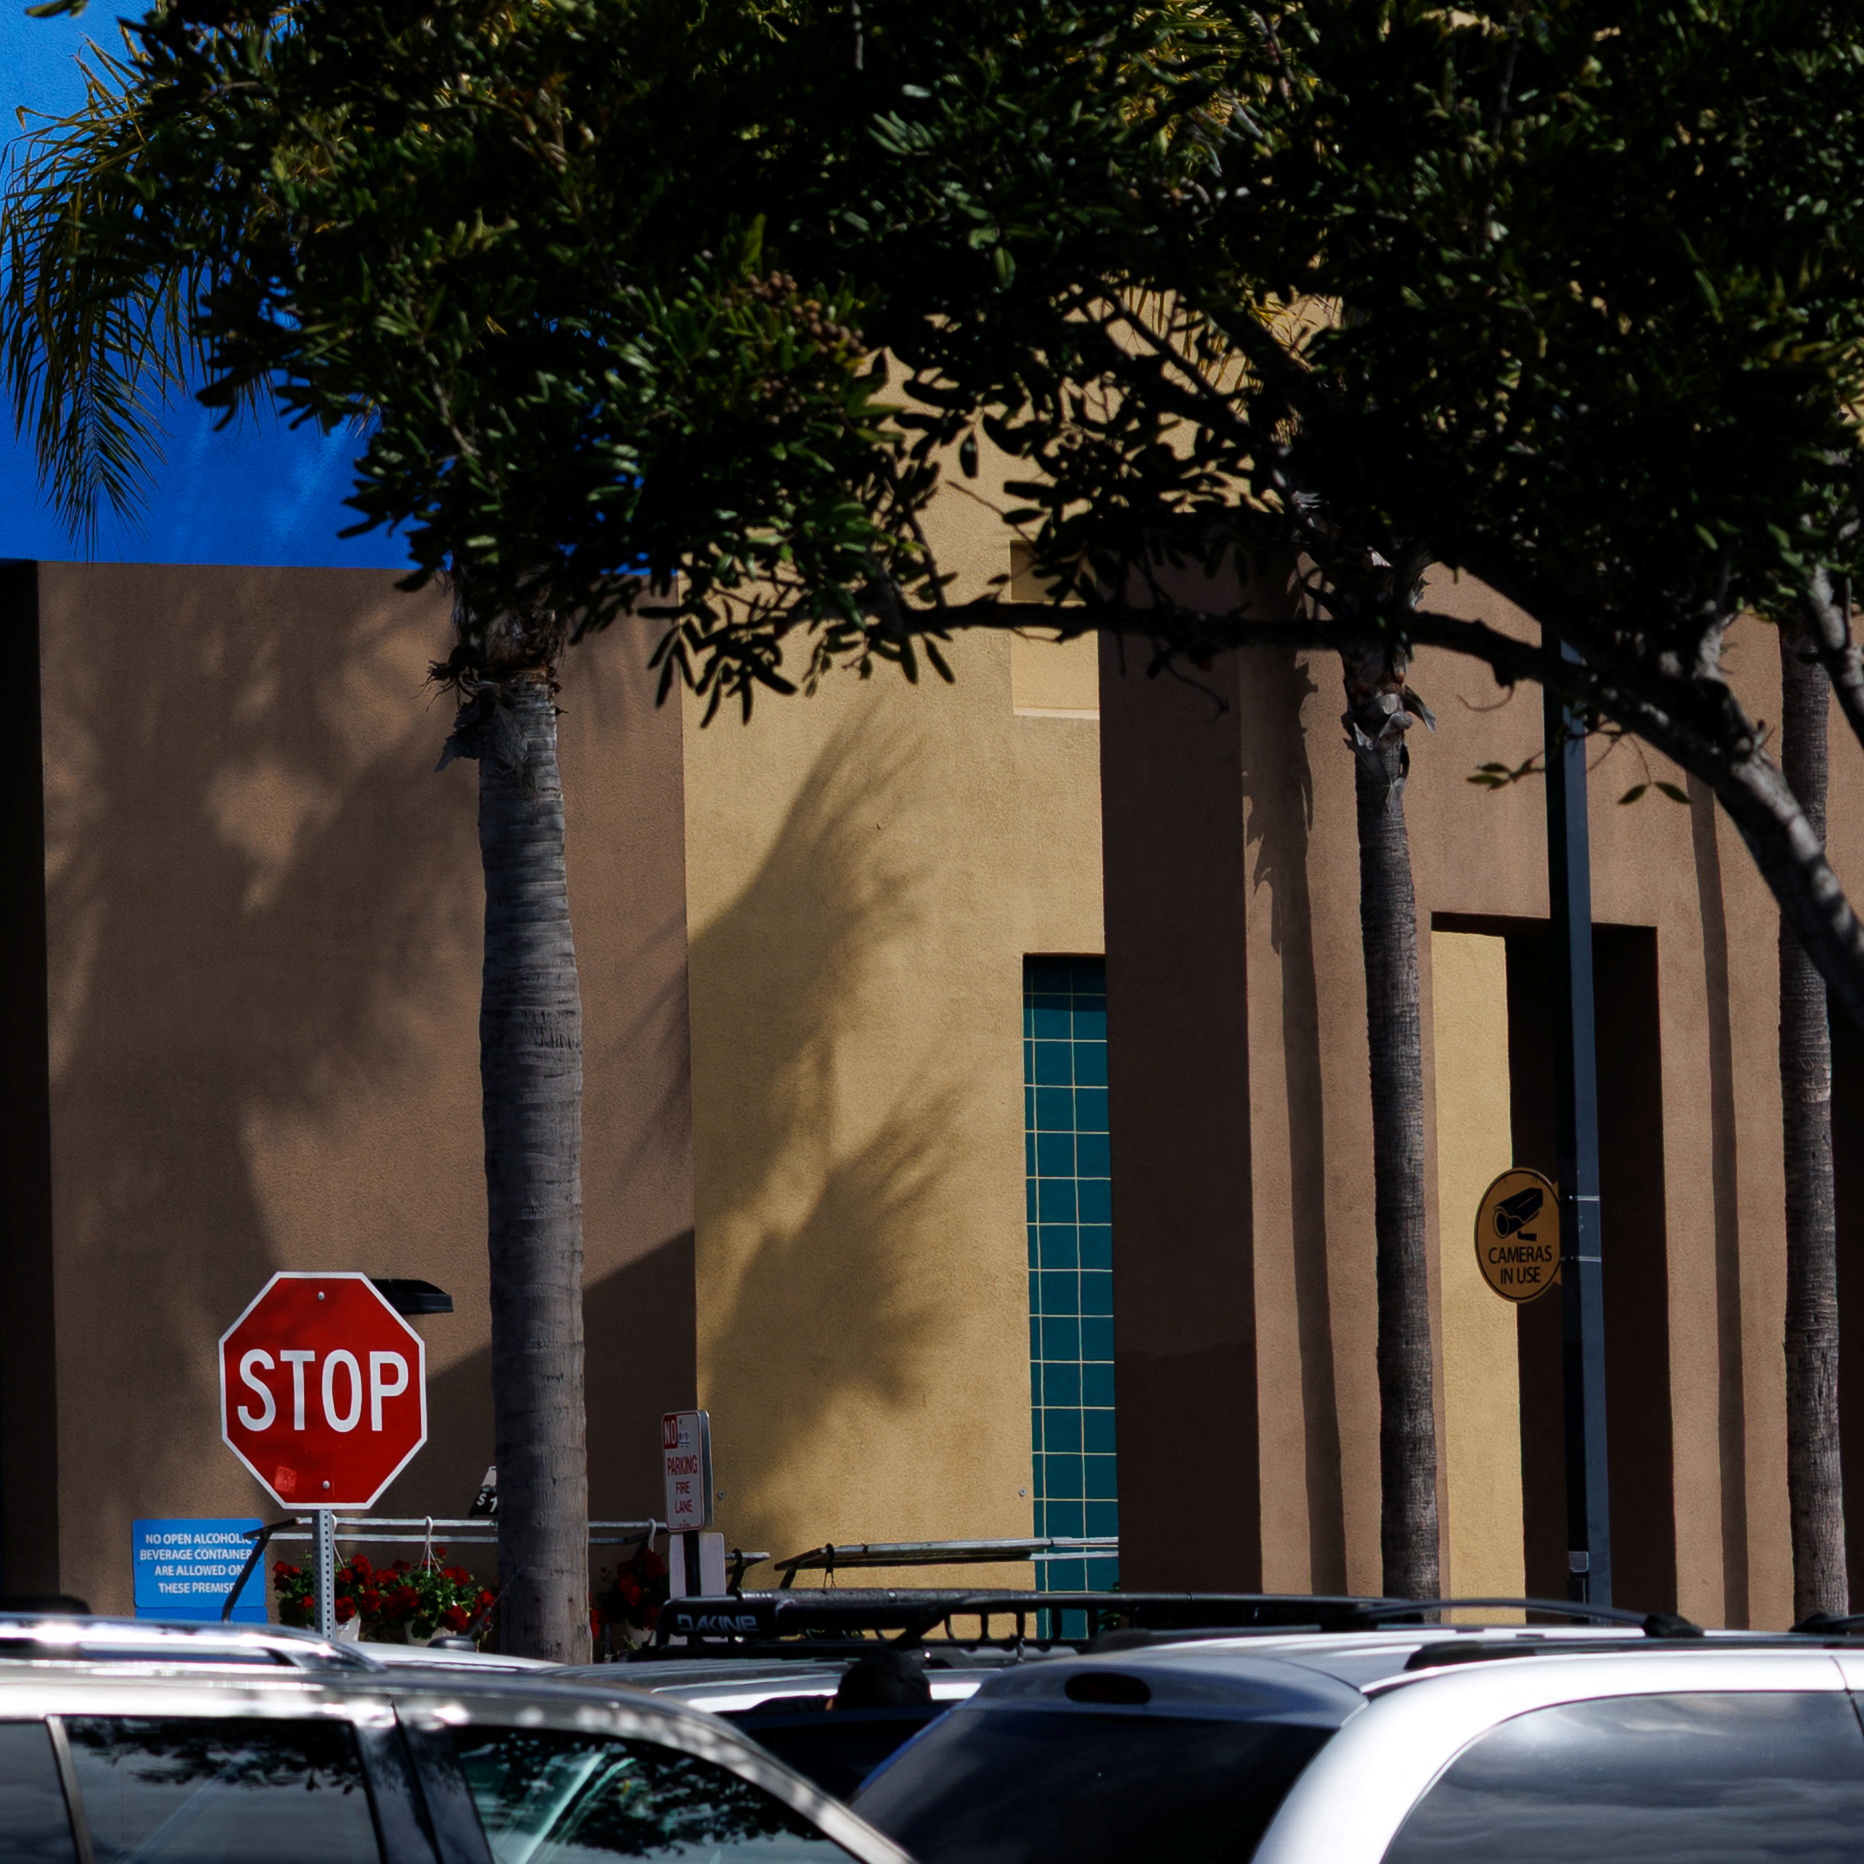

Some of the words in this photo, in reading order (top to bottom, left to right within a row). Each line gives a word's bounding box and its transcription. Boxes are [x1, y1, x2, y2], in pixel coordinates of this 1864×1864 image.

[1488, 1245, 1553, 1264] CAMERAS
[1500, 1267, 1513, 1285] IN
[1517, 1266, 1541, 1284] USE
[237, 1349, 410, 1432] STOP
[664, 1420, 677, 1445] NO
[667, 1454, 698, 1477] PARKING
[675, 1481, 690, 1494] FIRE
[674, 1499, 693, 1514] LANE
[145, 1534, 161, 1545] NO
[163, 1533, 192, 1544] OPEN
[140, 1549, 192, 1560] BEVERAGE
[194, 1549, 252, 1560] CONTAINER
[154, 1565, 174, 1576] ARE
[176, 1565, 226, 1576] ALLOWED
[228, 1564, 245, 1576] ON
[158, 1582, 191, 1594] THESE
[192, 1582, 235, 1594] PREMIS
